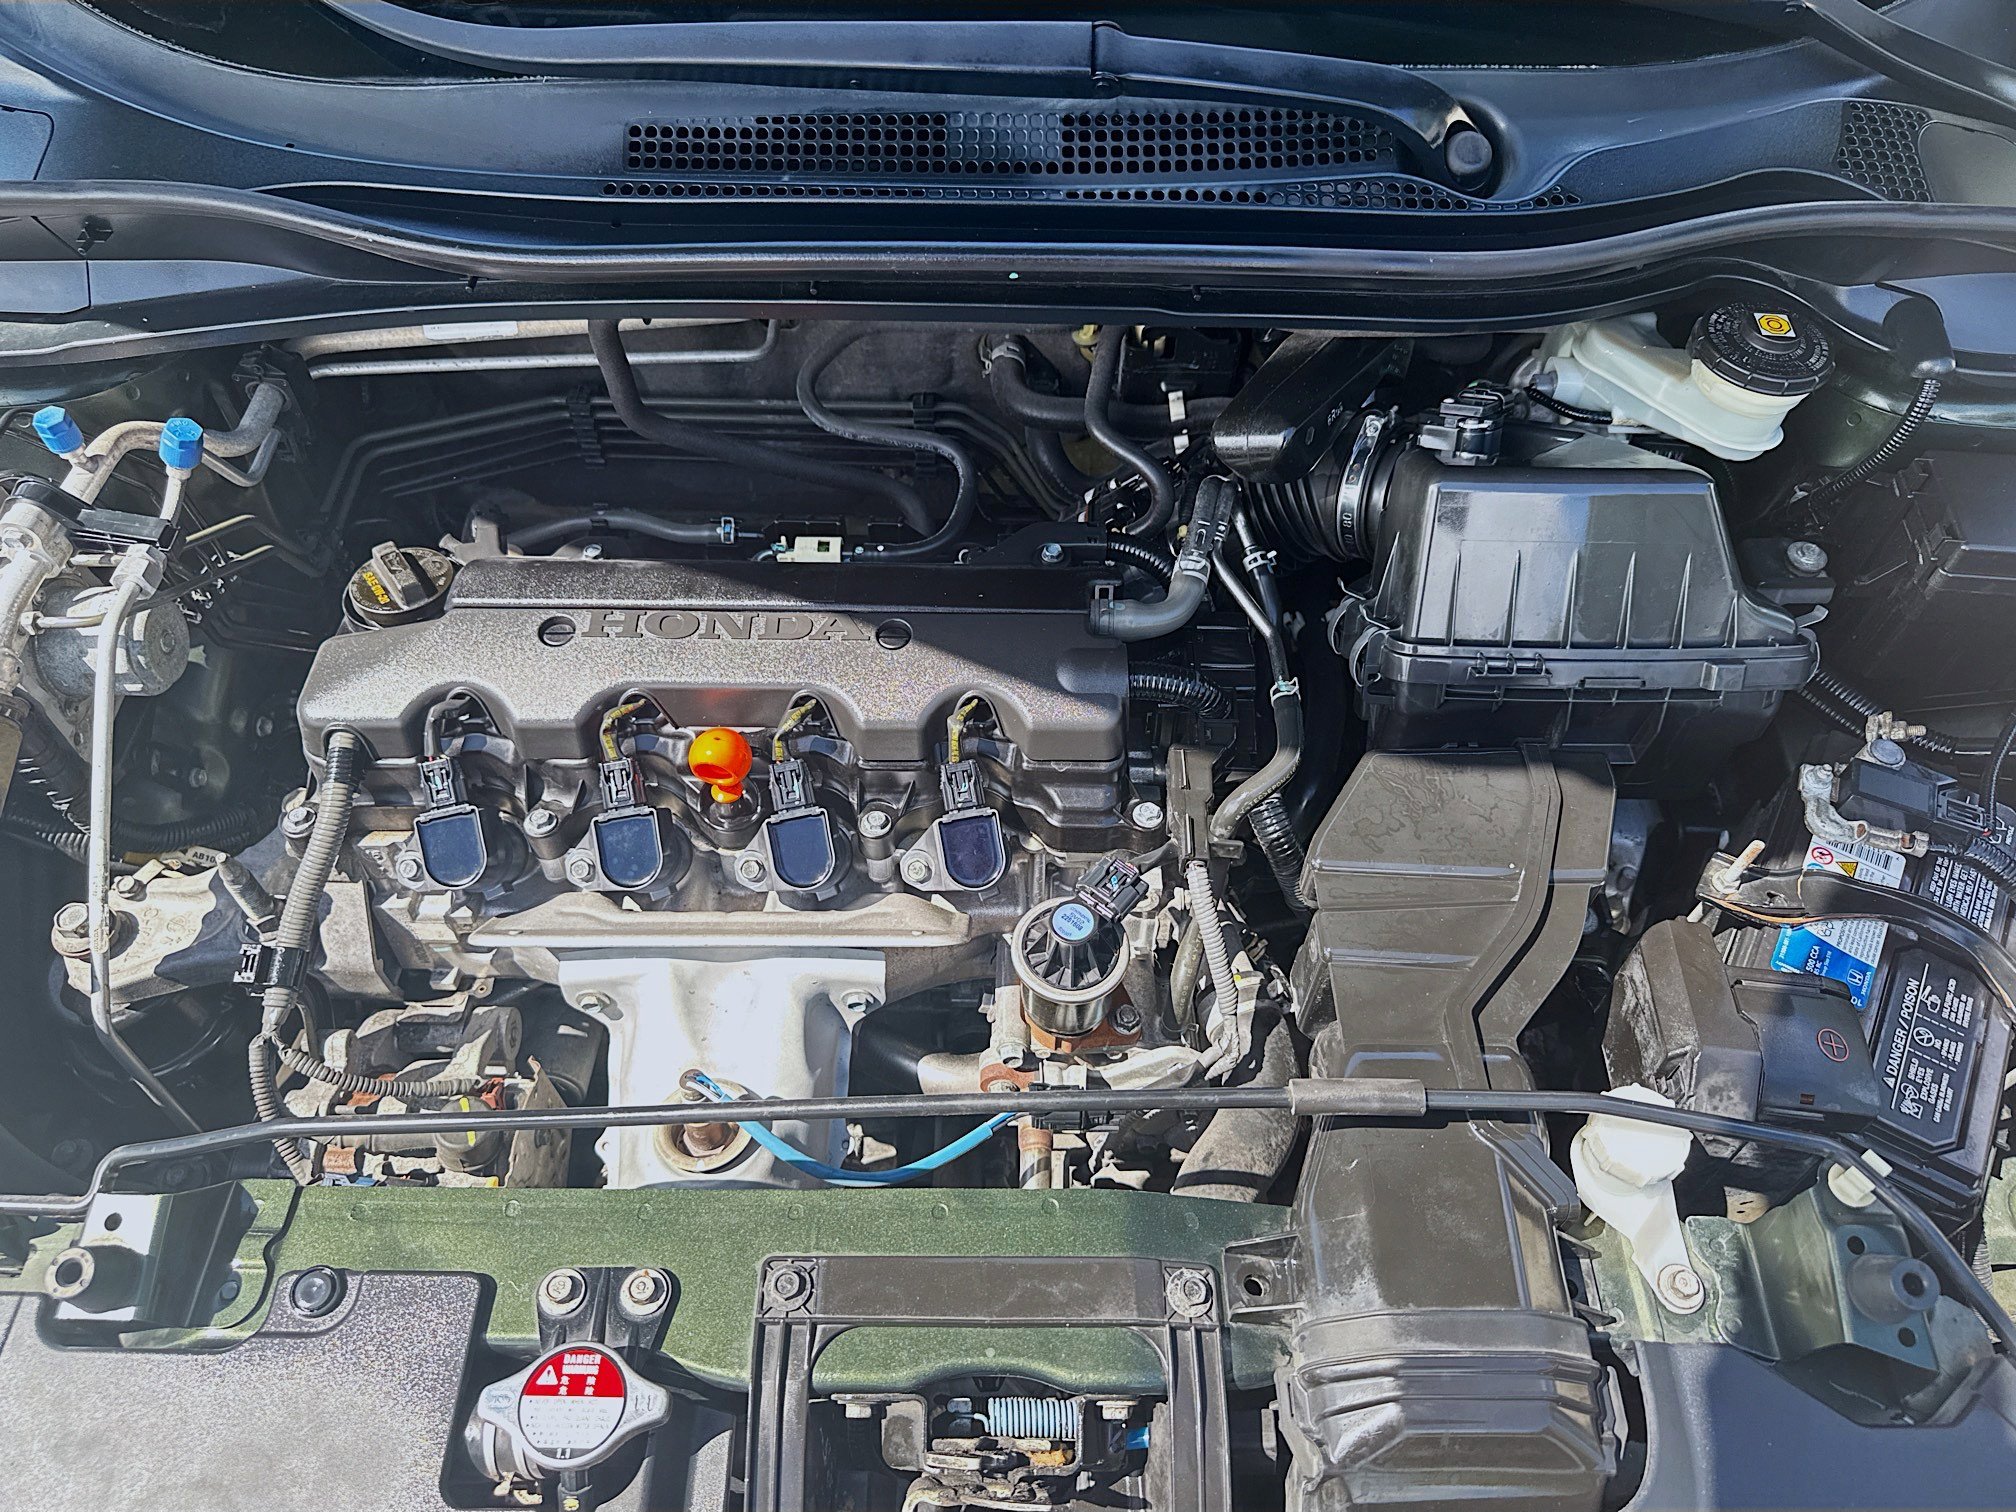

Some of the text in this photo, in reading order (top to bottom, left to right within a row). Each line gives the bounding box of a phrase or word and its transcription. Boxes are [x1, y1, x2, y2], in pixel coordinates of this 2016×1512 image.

[580, 610, 871, 642] HONDA
[1960, 869, 1968, 880] GET
[1948, 879, 1957, 893] EYES
[1965, 880, 1973, 894] HELP
[1805, 945, 1820, 971] 500 CCA
[1861, 971, 1872, 995] HONDA
[1947, 978, 1956, 993] ACID
[1886, 1028, 1907, 1076] DANGER
[1900, 977, 1919, 1019] POISON
[1934, 1039, 1941, 1049] NO
[1907, 1057, 1918, 1080] SHIELD
[1915, 1067, 1925, 1083] EYES
[1920, 1067, 1933, 1100] EXPLOSIVE
[1928, 1083, 1938, 1104] GASES
[563, 1354, 602, 1365] DANGER
[556, 1448, 571, 1459] 1.1
